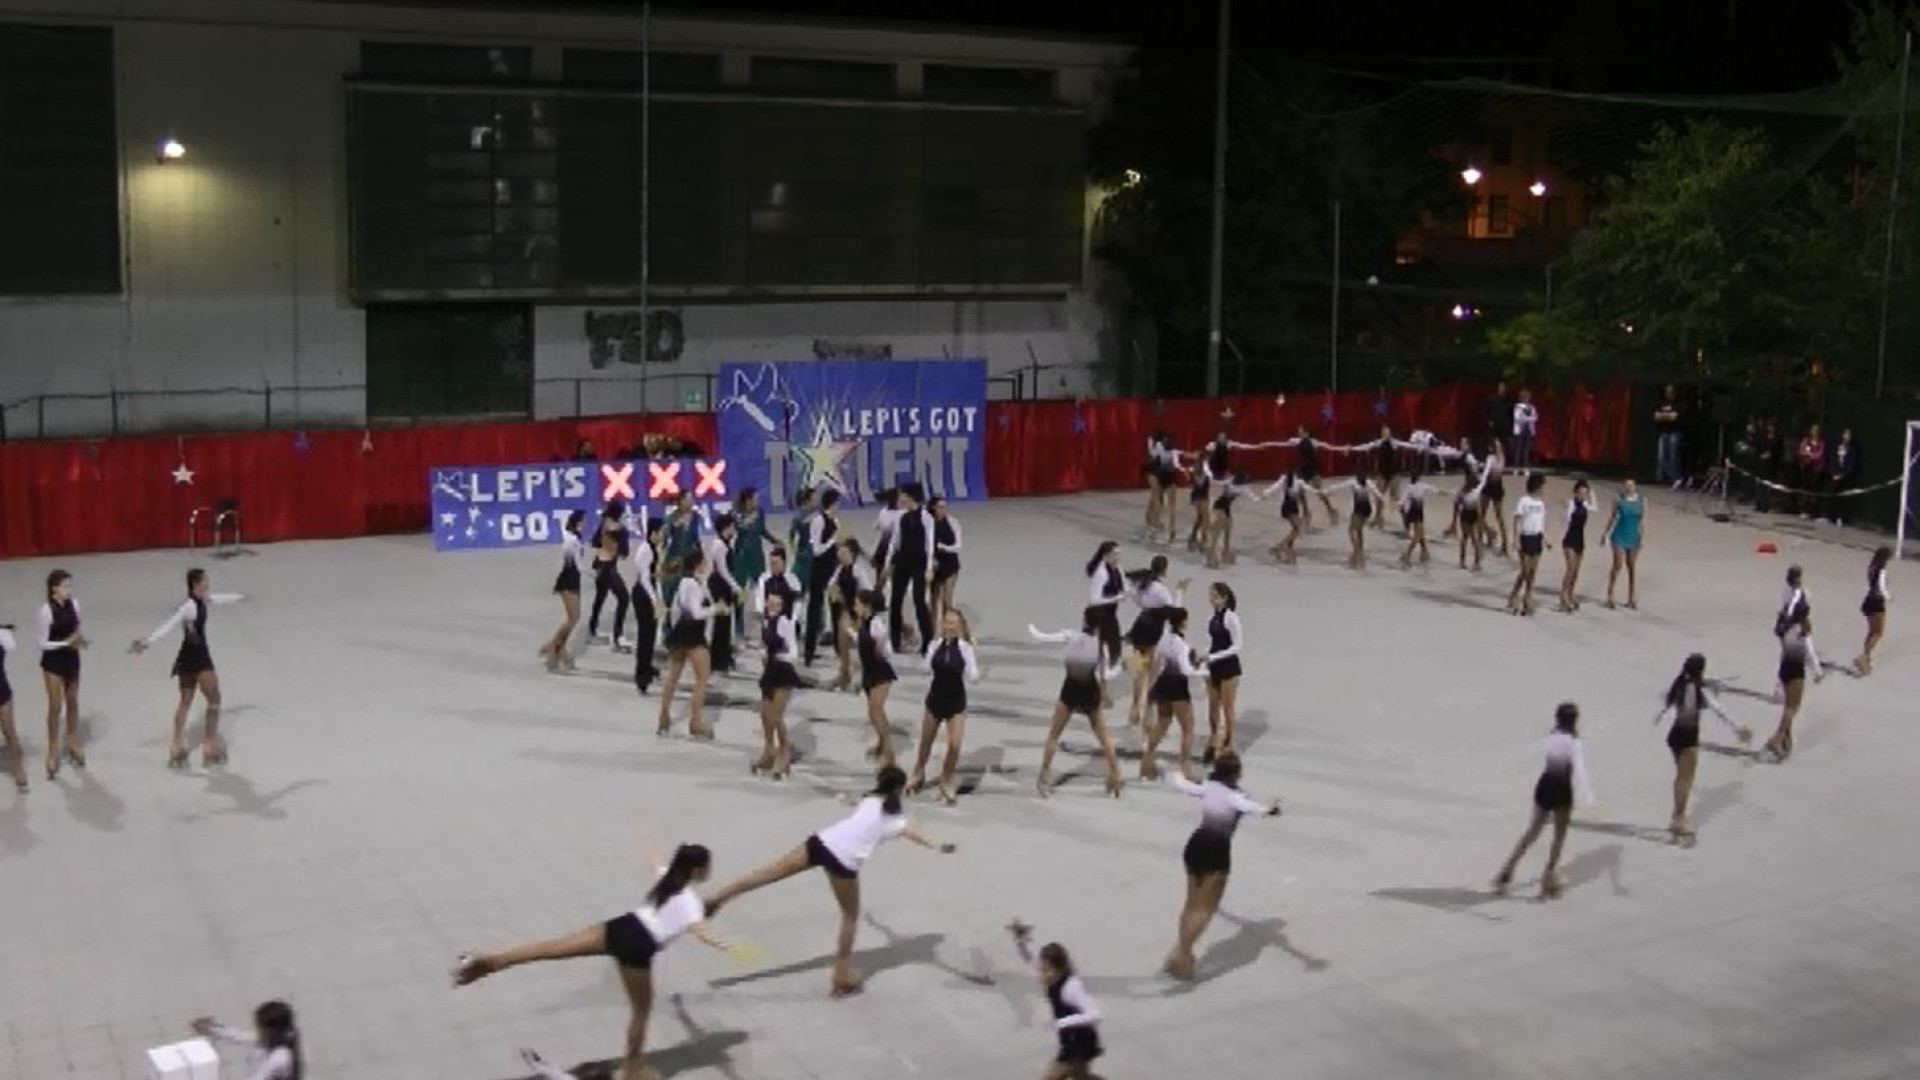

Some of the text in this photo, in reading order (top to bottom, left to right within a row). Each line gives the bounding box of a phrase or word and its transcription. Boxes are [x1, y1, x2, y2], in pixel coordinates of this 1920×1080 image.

[843, 406, 978, 436] LEPI'S GOT
[471, 467, 586, 502] LEPI'S
[501, 509, 573, 541] GOT
